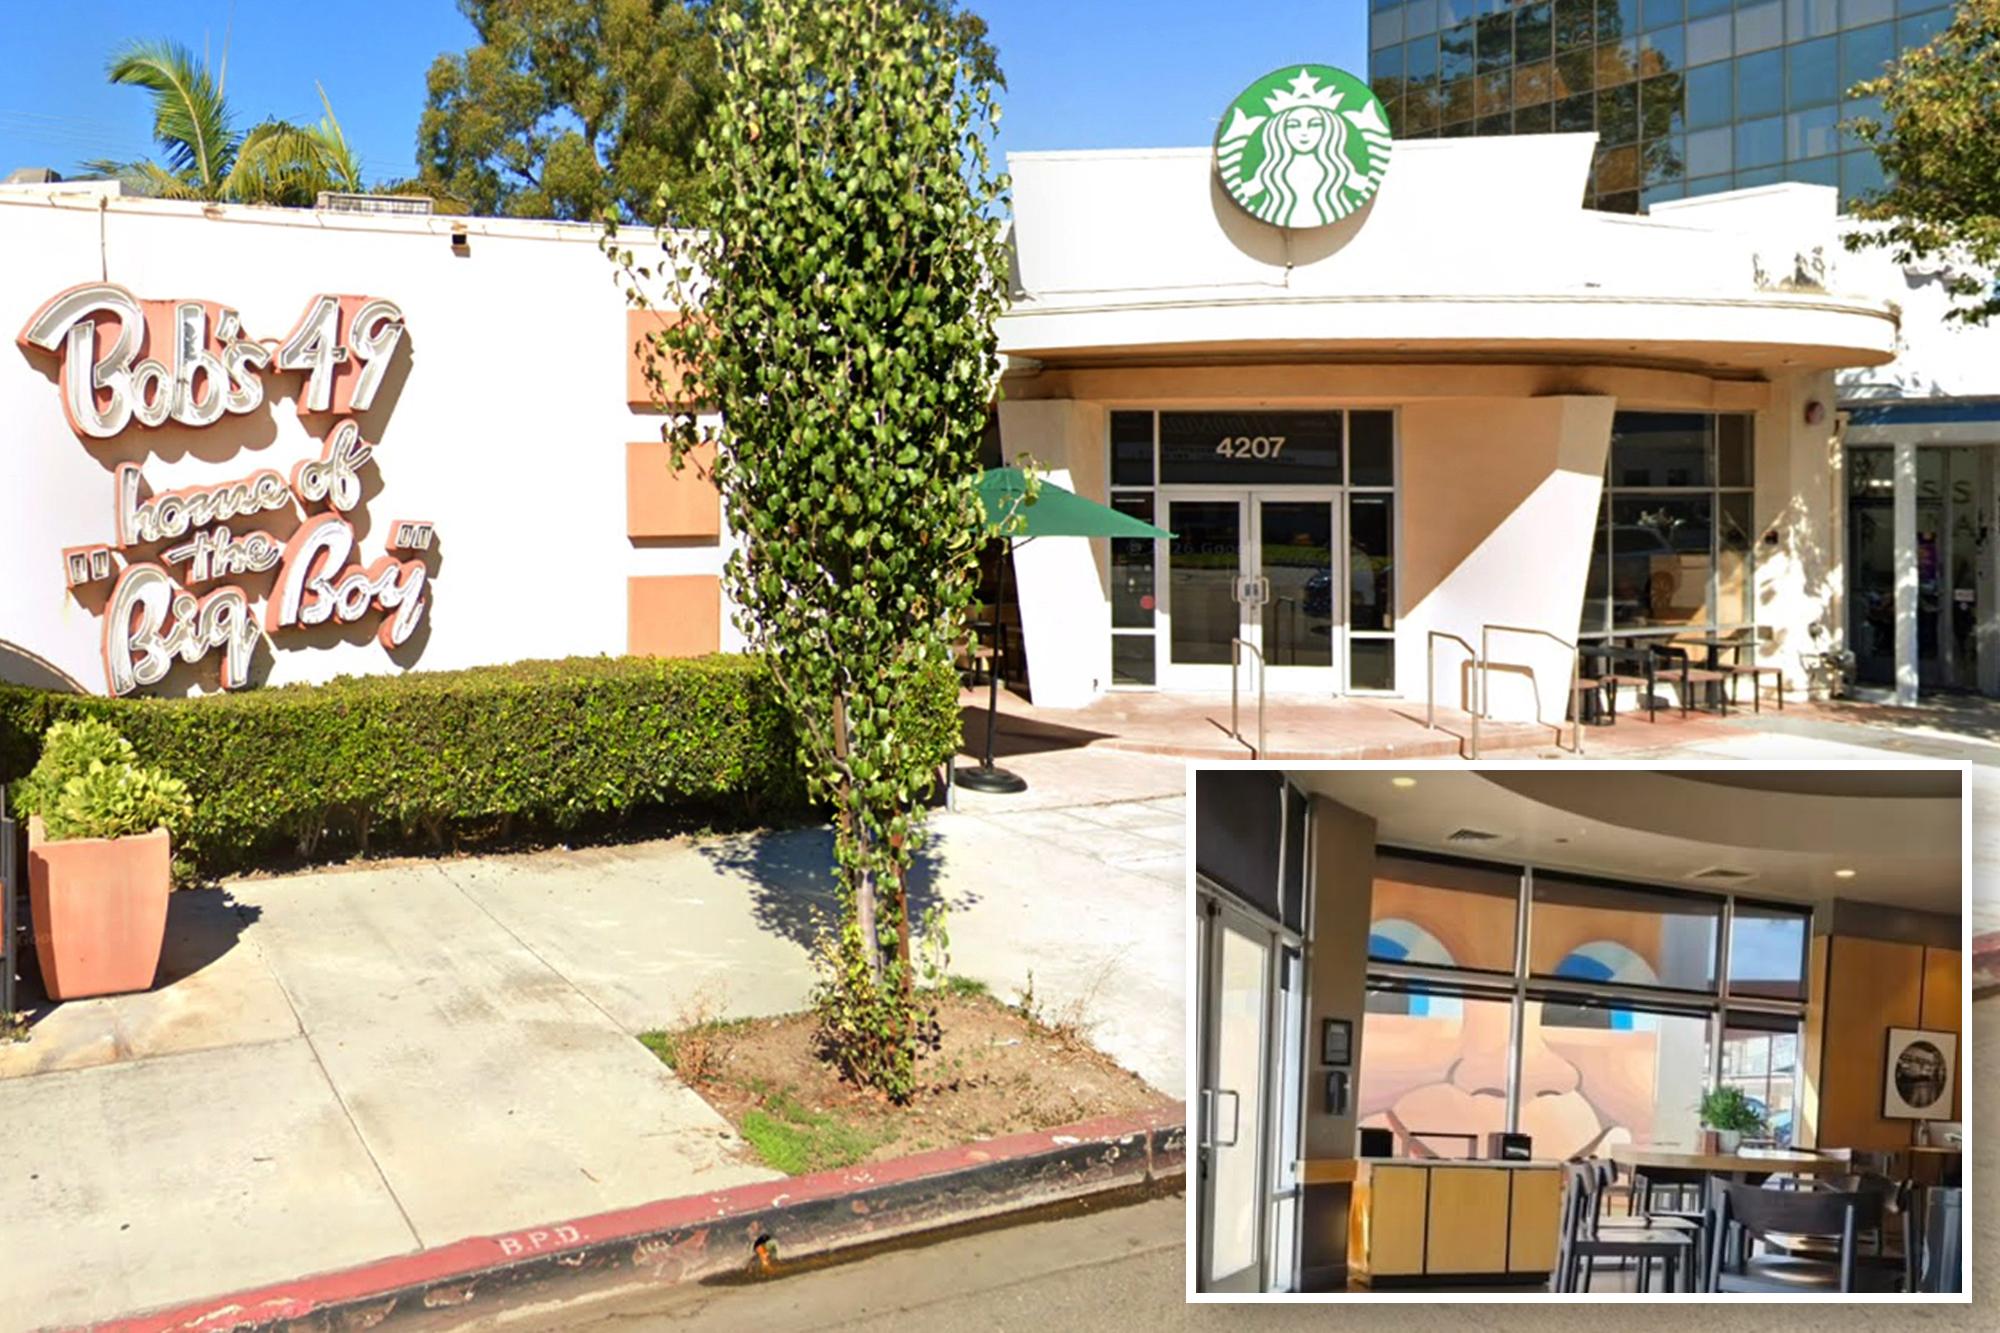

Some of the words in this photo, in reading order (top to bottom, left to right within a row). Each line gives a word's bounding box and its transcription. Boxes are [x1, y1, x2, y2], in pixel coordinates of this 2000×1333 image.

[26, 286, 271, 437] Bob's
[278, 296, 403, 411] 49
[119, 465, 291, 545] home
[300, 422, 372, 511] of
[1216, 436, 1286, 458] 4207
[166, 526, 279, 580] the
